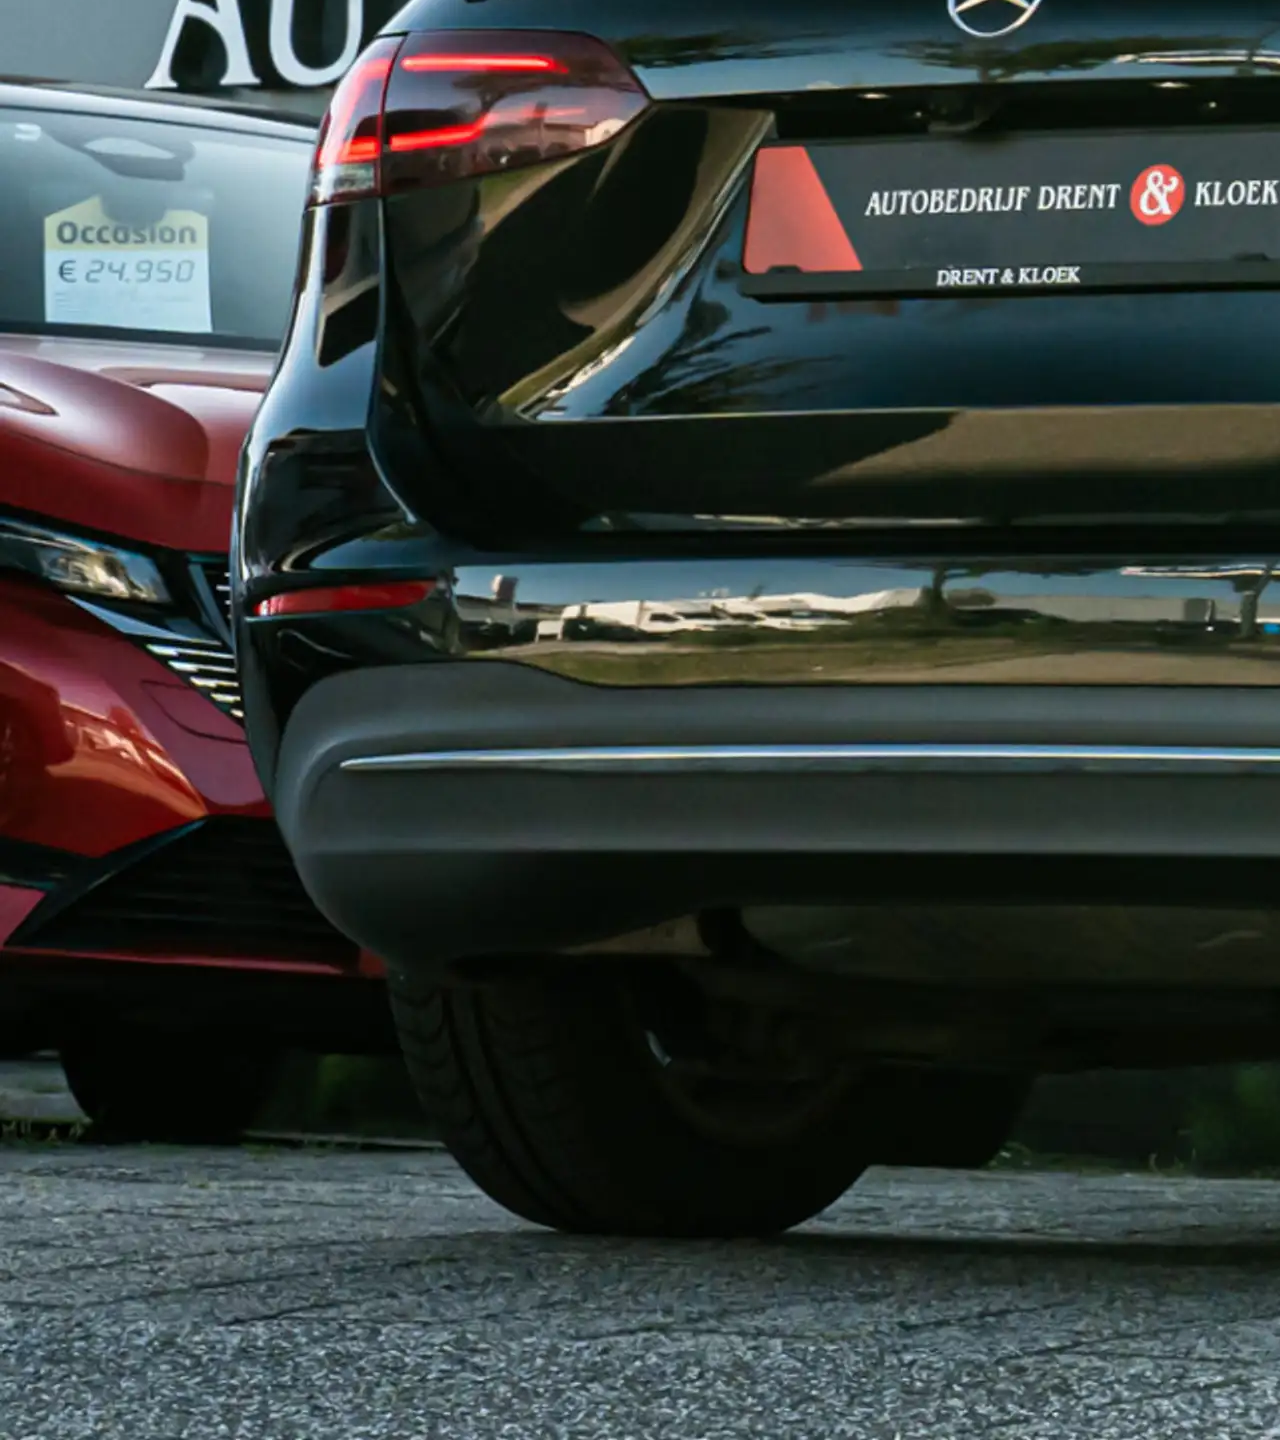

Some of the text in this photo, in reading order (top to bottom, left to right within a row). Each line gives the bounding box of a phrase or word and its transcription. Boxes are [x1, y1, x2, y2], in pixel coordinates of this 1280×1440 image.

[864, 169, 1280, 217] AUTOBEDRIJF DRENT & KLOEK
[56, 220, 197, 245] Occasion
[936, 265, 1081, 287] DRENT & KLOEK
